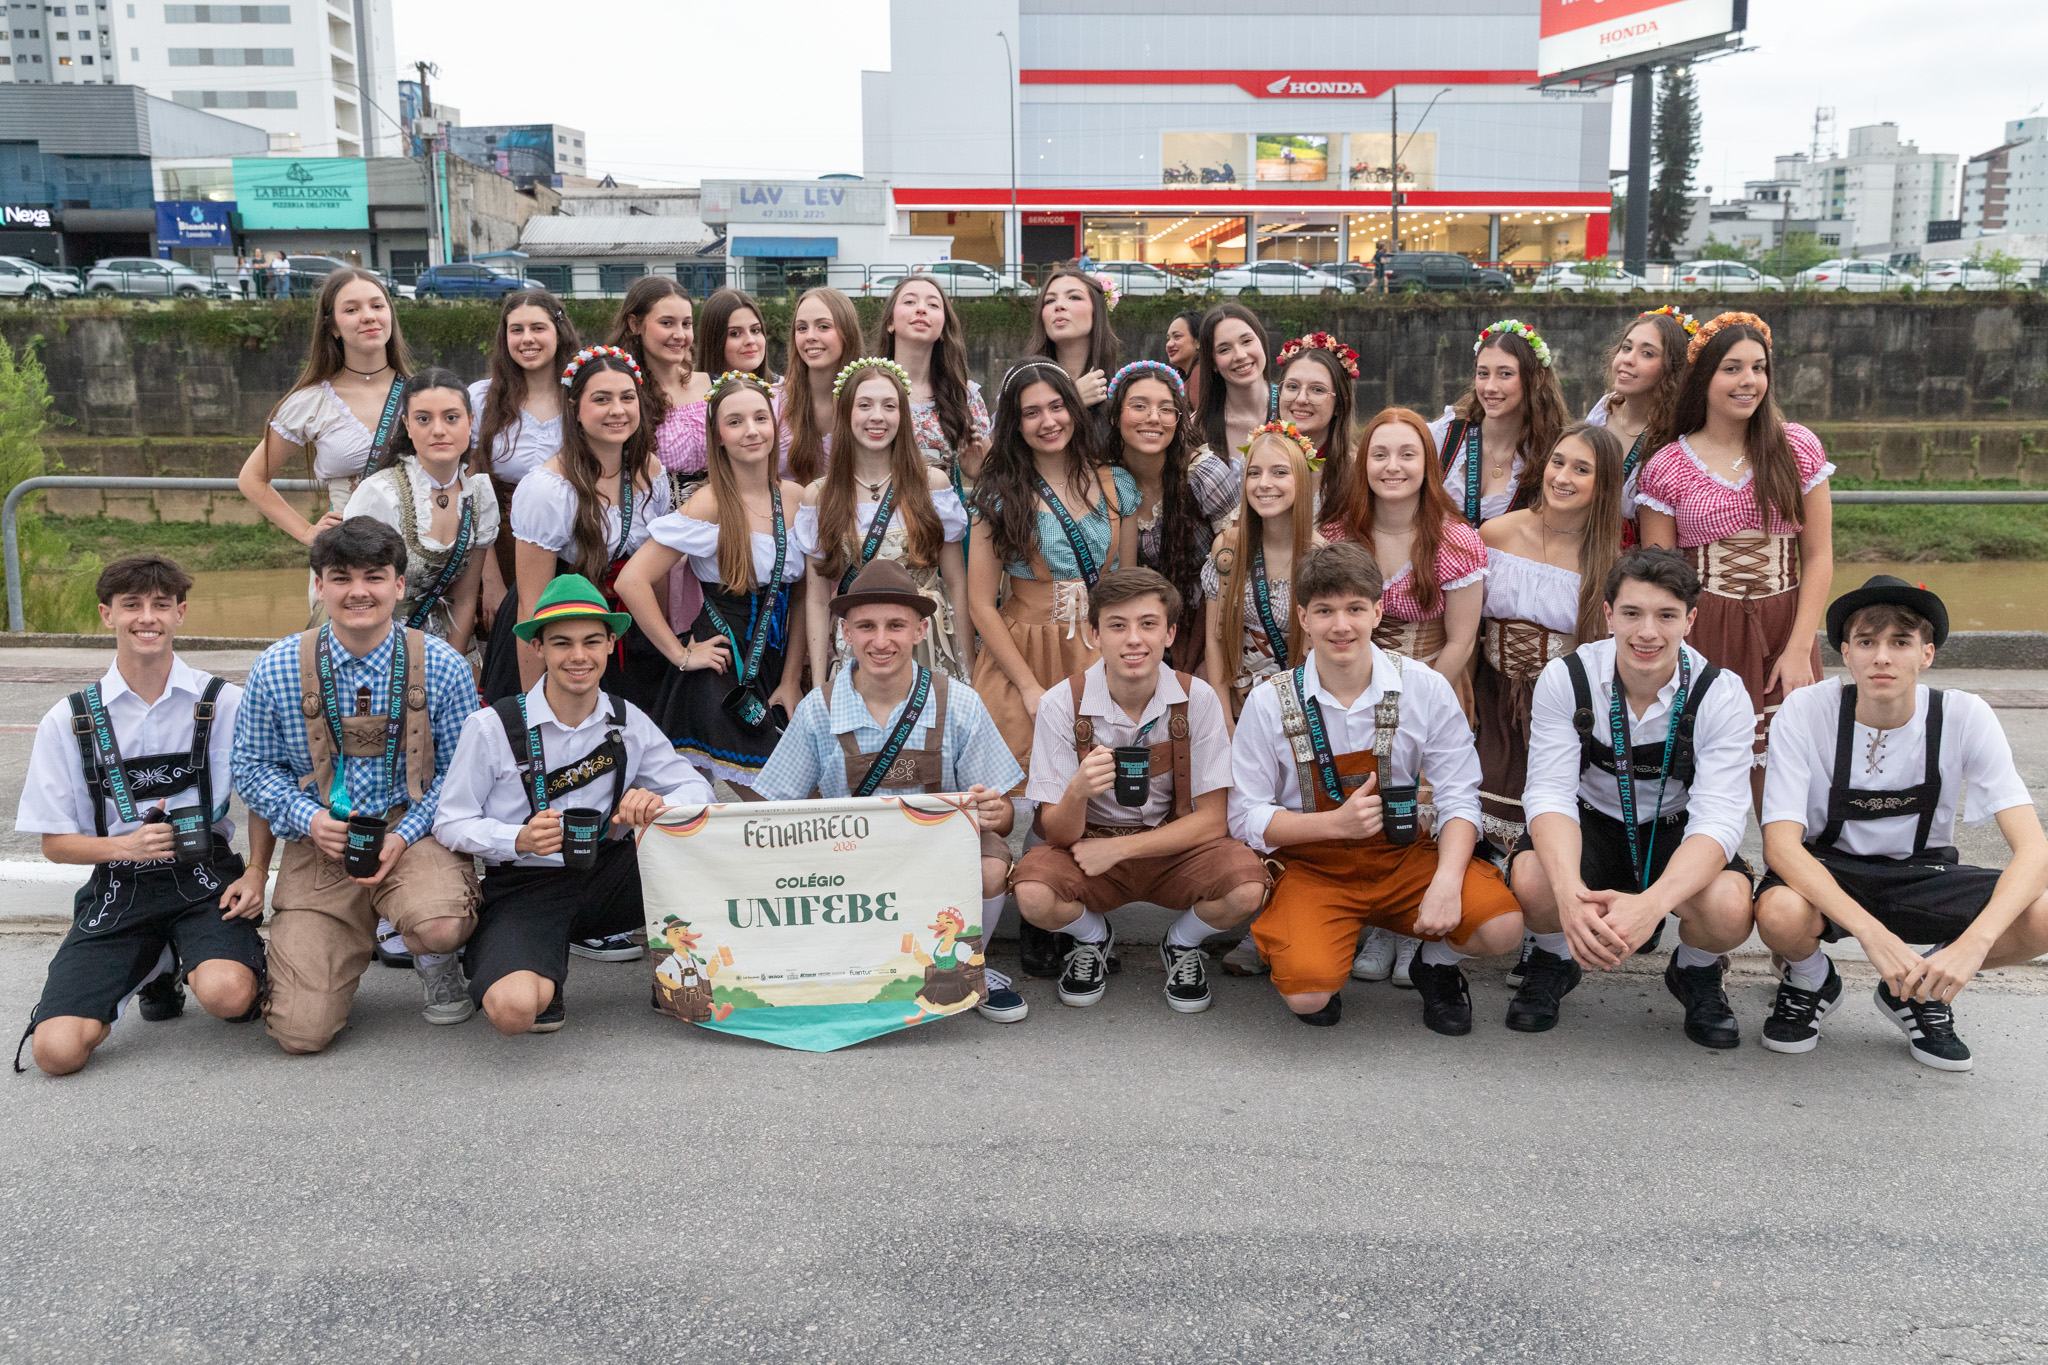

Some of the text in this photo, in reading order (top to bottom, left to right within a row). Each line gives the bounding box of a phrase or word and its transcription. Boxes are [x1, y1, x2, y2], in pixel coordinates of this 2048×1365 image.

[1600, 21, 1659, 45] HONDA
[1289, 82, 1367, 94] HONDA
[255, 188, 350, 198] LA BELLA DONNA
[740, 187, 846, 206] LAV LEV
[5, 206, 50, 222] Nexa
[762, 210, 826, 218] 47 3351 2725
[1028, 216, 1065, 224] SERVIÇOS
[381, 382, 403, 428] TERCEIRÃO
[375, 427, 387, 446] 2026
[1468, 439, 1479, 496] TERCEIRÃO
[1051, 497, 1067, 517] 2026
[1467, 498, 1476, 518] 2026
[440, 510, 472, 583] TERCEIRÃO 2026
[863, 537, 878, 559] 2026
[1063, 516, 1093, 572] TERCEIRÃO
[771, 516, 786, 595] TERCEIRÃO 2026
[1256, 580, 1268, 602] 2026
[419, 596, 436, 616] 2026
[760, 610, 771, 631] 2026
[1262, 603, 1286, 656] TERCEIRÃO
[320, 655, 331, 679] 2026
[390, 632, 406, 719] TERCEIRÃO 2026
[97, 727, 111, 751] 2026
[1613, 732, 1625, 756] 2026
[860, 722, 911, 797] TERCEIRÃO 2026
[536, 775, 546, 799] 2026
[1323, 767, 1336, 788] 2026
[1619, 774, 1636, 840] TERCEIRÃO
[833, 840, 857, 851] 2026
[775, 873, 845, 889] COLÉGIO
[725, 891, 899, 929] UNIFEBE
